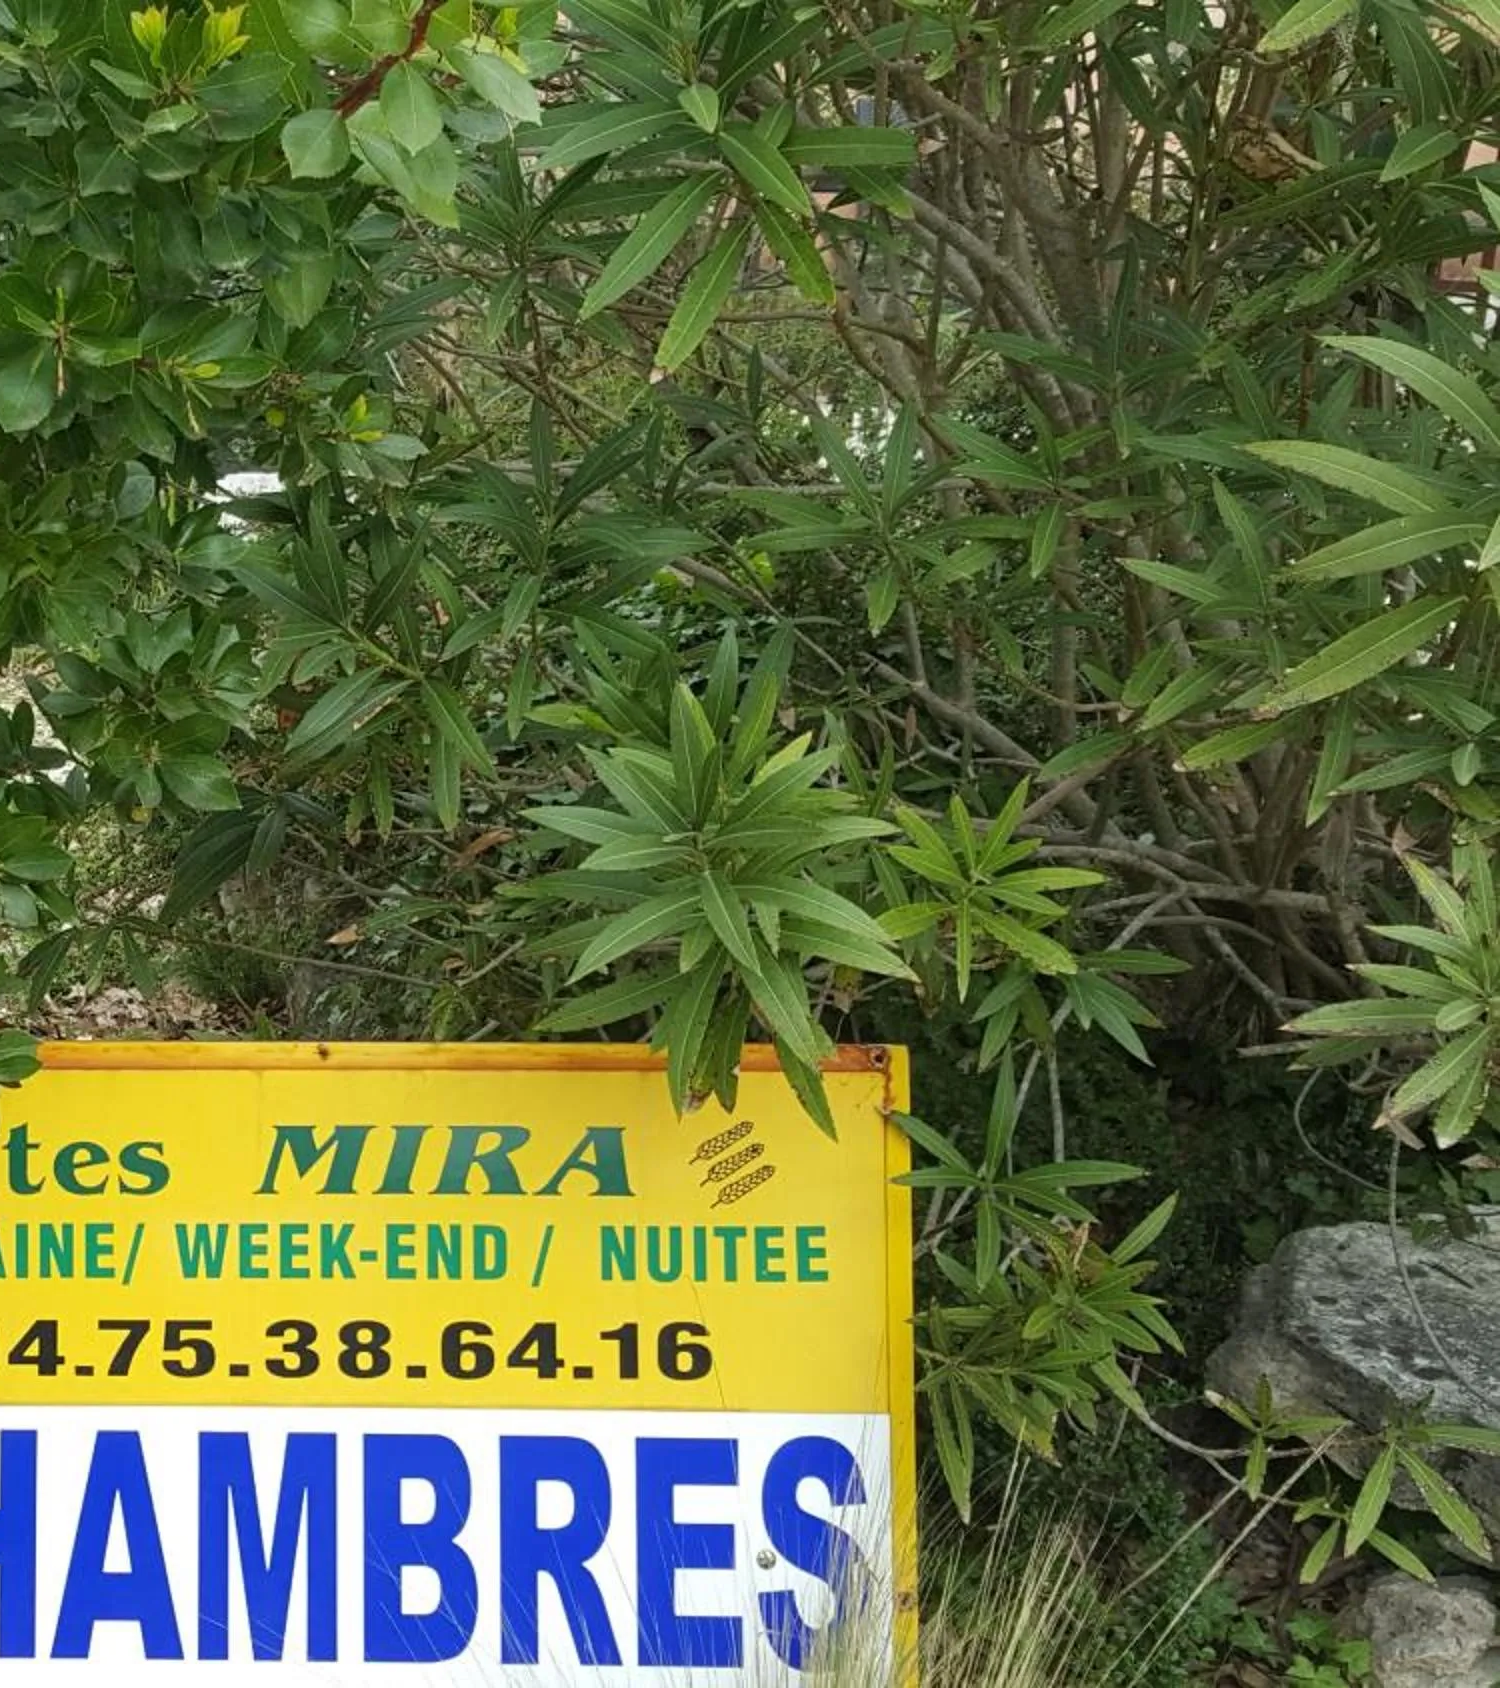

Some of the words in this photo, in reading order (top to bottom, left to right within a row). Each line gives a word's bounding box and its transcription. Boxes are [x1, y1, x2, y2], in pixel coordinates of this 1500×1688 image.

[252, 1124, 637, 1197] MIRA
[175, 1223, 508, 1280] WEEK-END
[601, 1225, 829, 1282] NUITEE
